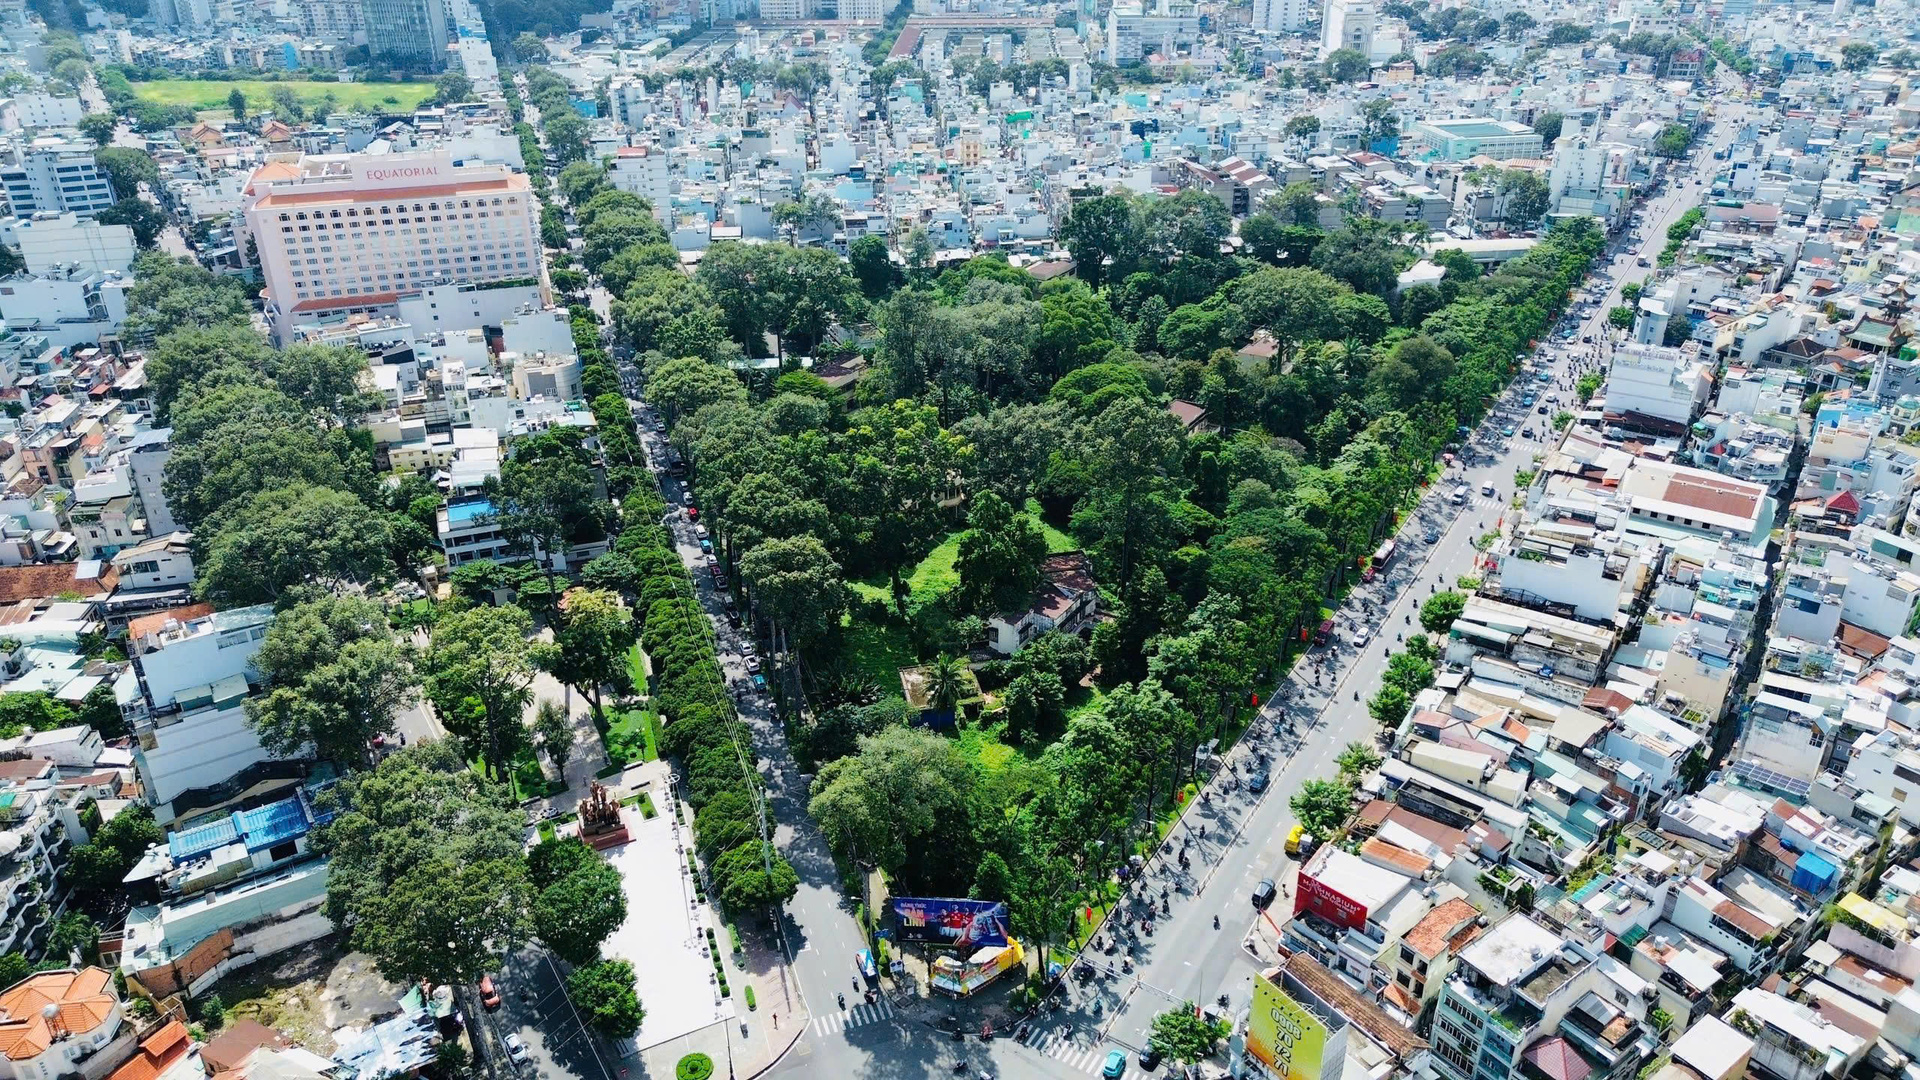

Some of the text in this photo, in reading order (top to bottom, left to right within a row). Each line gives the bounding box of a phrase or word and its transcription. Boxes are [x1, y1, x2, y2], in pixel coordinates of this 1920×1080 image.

[366, 166, 438, 180] EQUATORIAL
[1303, 879, 1356, 911] MHNASIUM
[1271, 1007, 1301, 1040] 0908
[1276, 1026, 1293, 1048] 70
[1274, 1040, 1291, 1063] 72
[1273, 1054, 1288, 1077] 71
